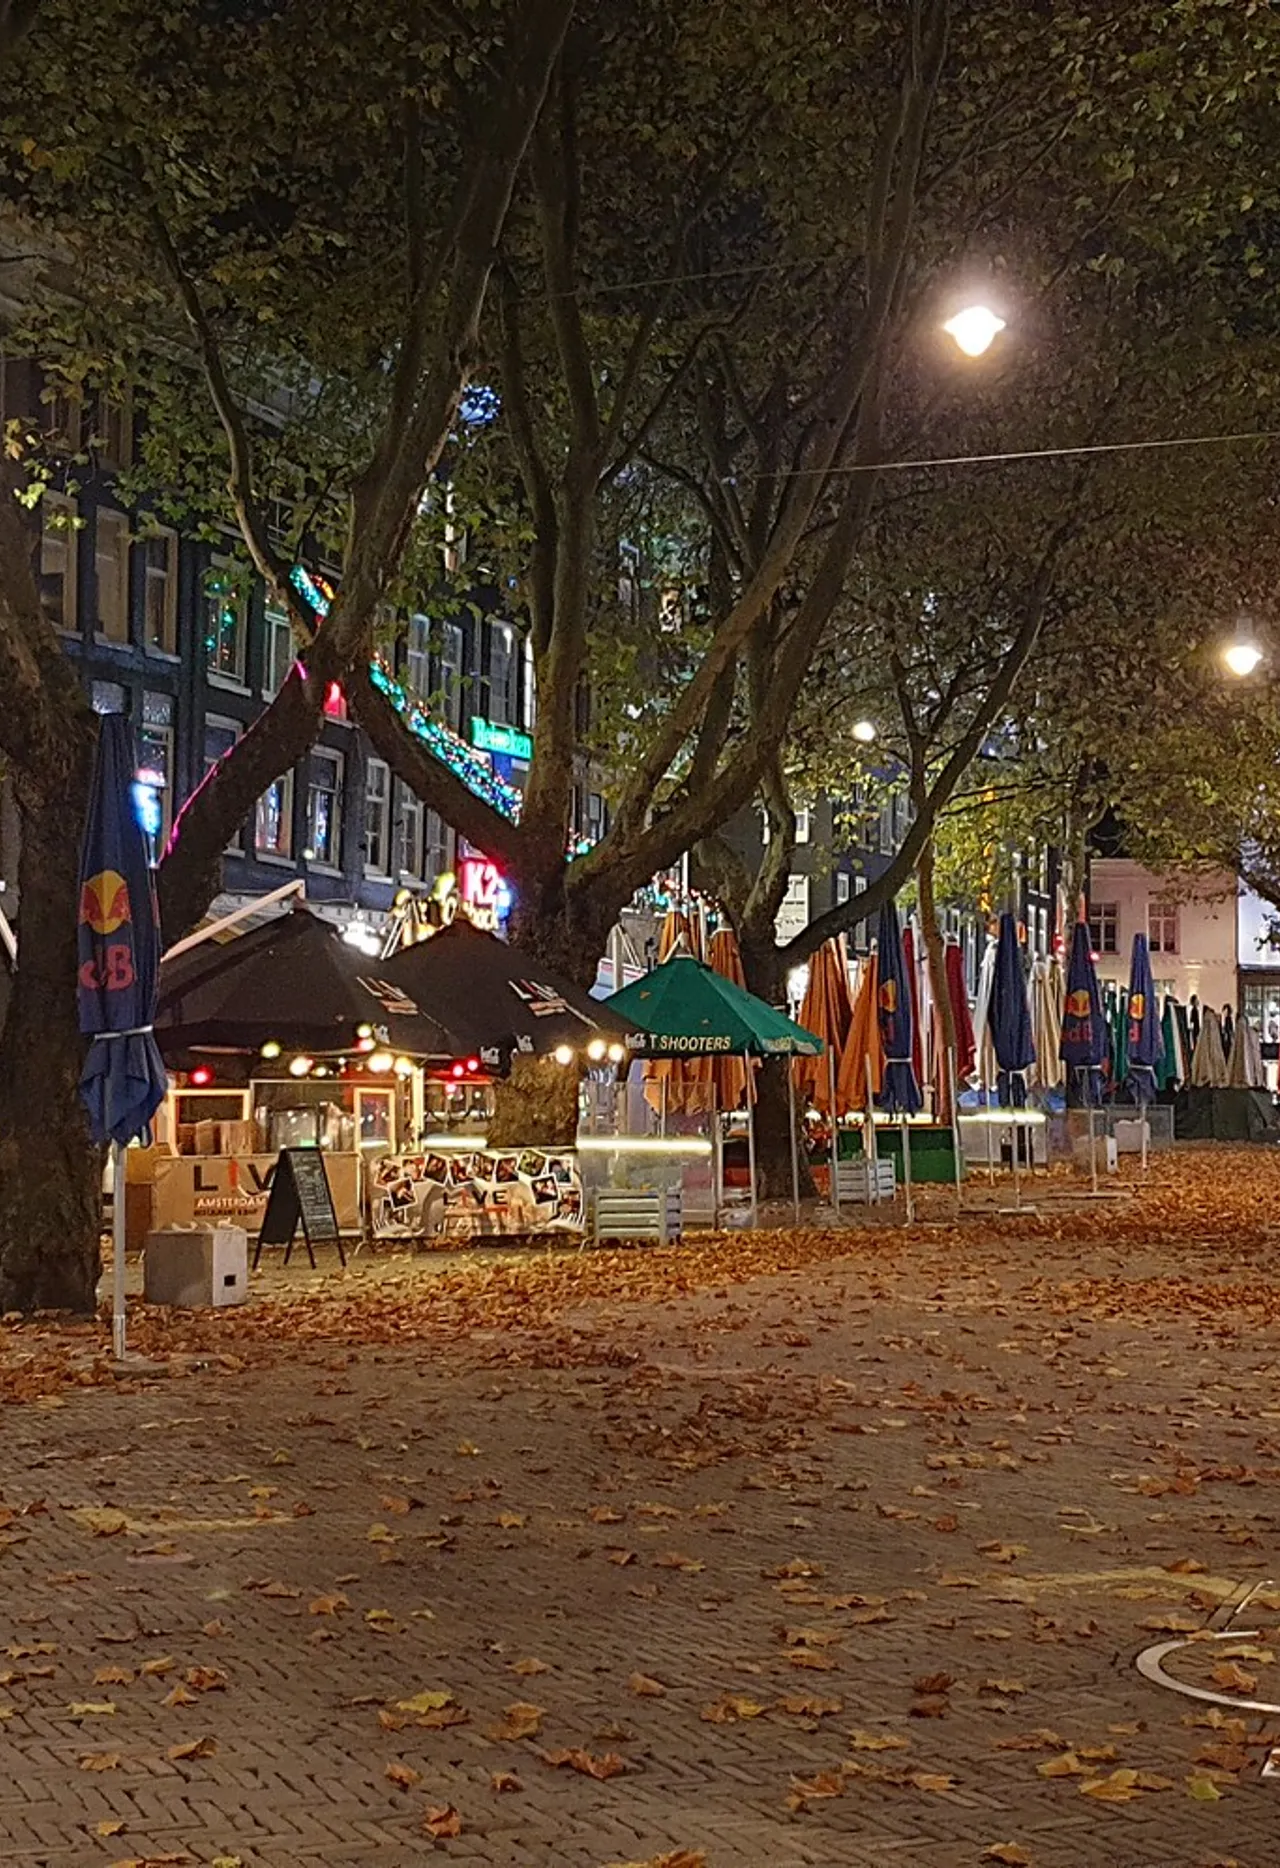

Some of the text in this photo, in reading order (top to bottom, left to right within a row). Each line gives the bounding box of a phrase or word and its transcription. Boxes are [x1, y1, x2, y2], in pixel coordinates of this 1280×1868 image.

[659, 1034, 732, 1051] SHOOTERS
[193, 1159, 278, 1194] LIV
[197, 1198, 268, 1209] AMSTERDAM
